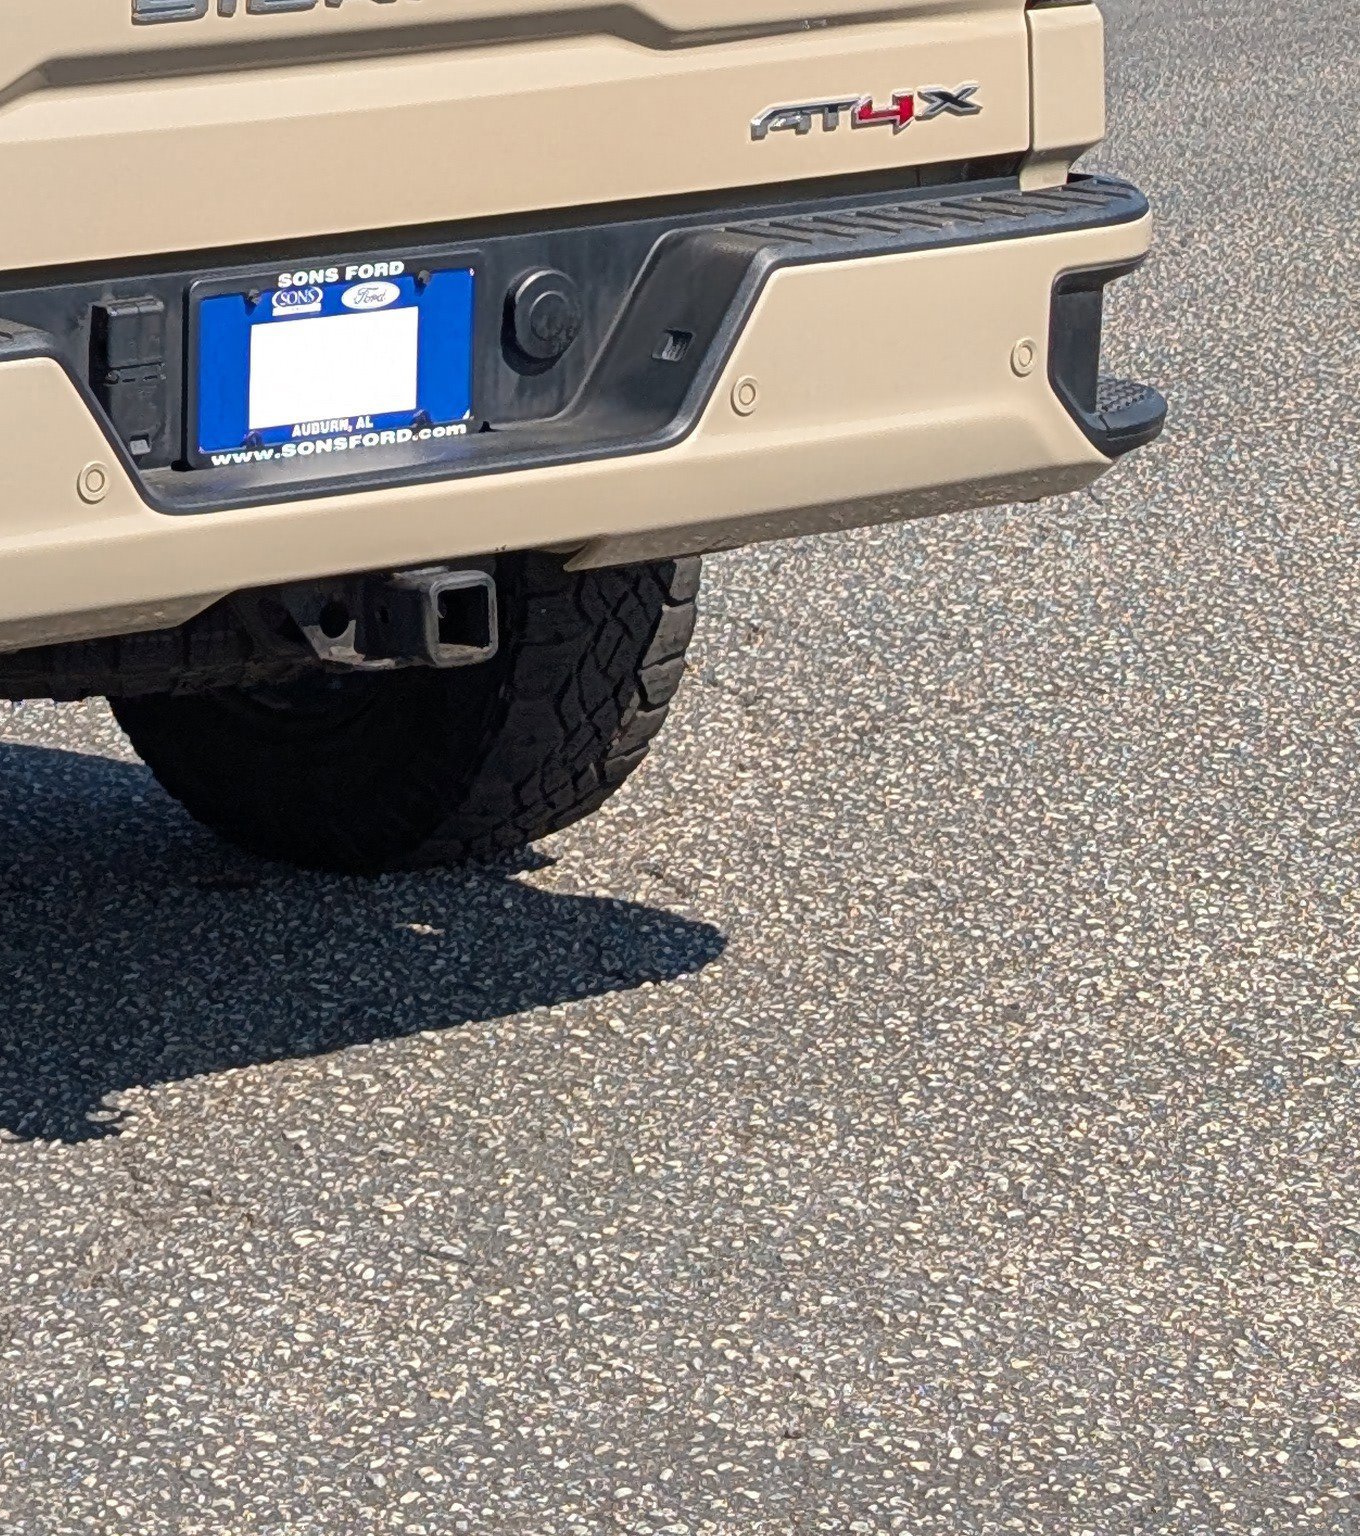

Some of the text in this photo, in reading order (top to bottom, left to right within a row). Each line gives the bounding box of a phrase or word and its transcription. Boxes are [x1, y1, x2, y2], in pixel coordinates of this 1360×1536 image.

[750, 80, 983, 141] AT4X
[278, 261, 405, 288] SONS FORD
[280, 286, 316, 305] SONS
[353, 286, 386, 305] Ford
[356, 415, 374, 430] AL
[211, 423, 467, 465] www.SONSFORD.com
